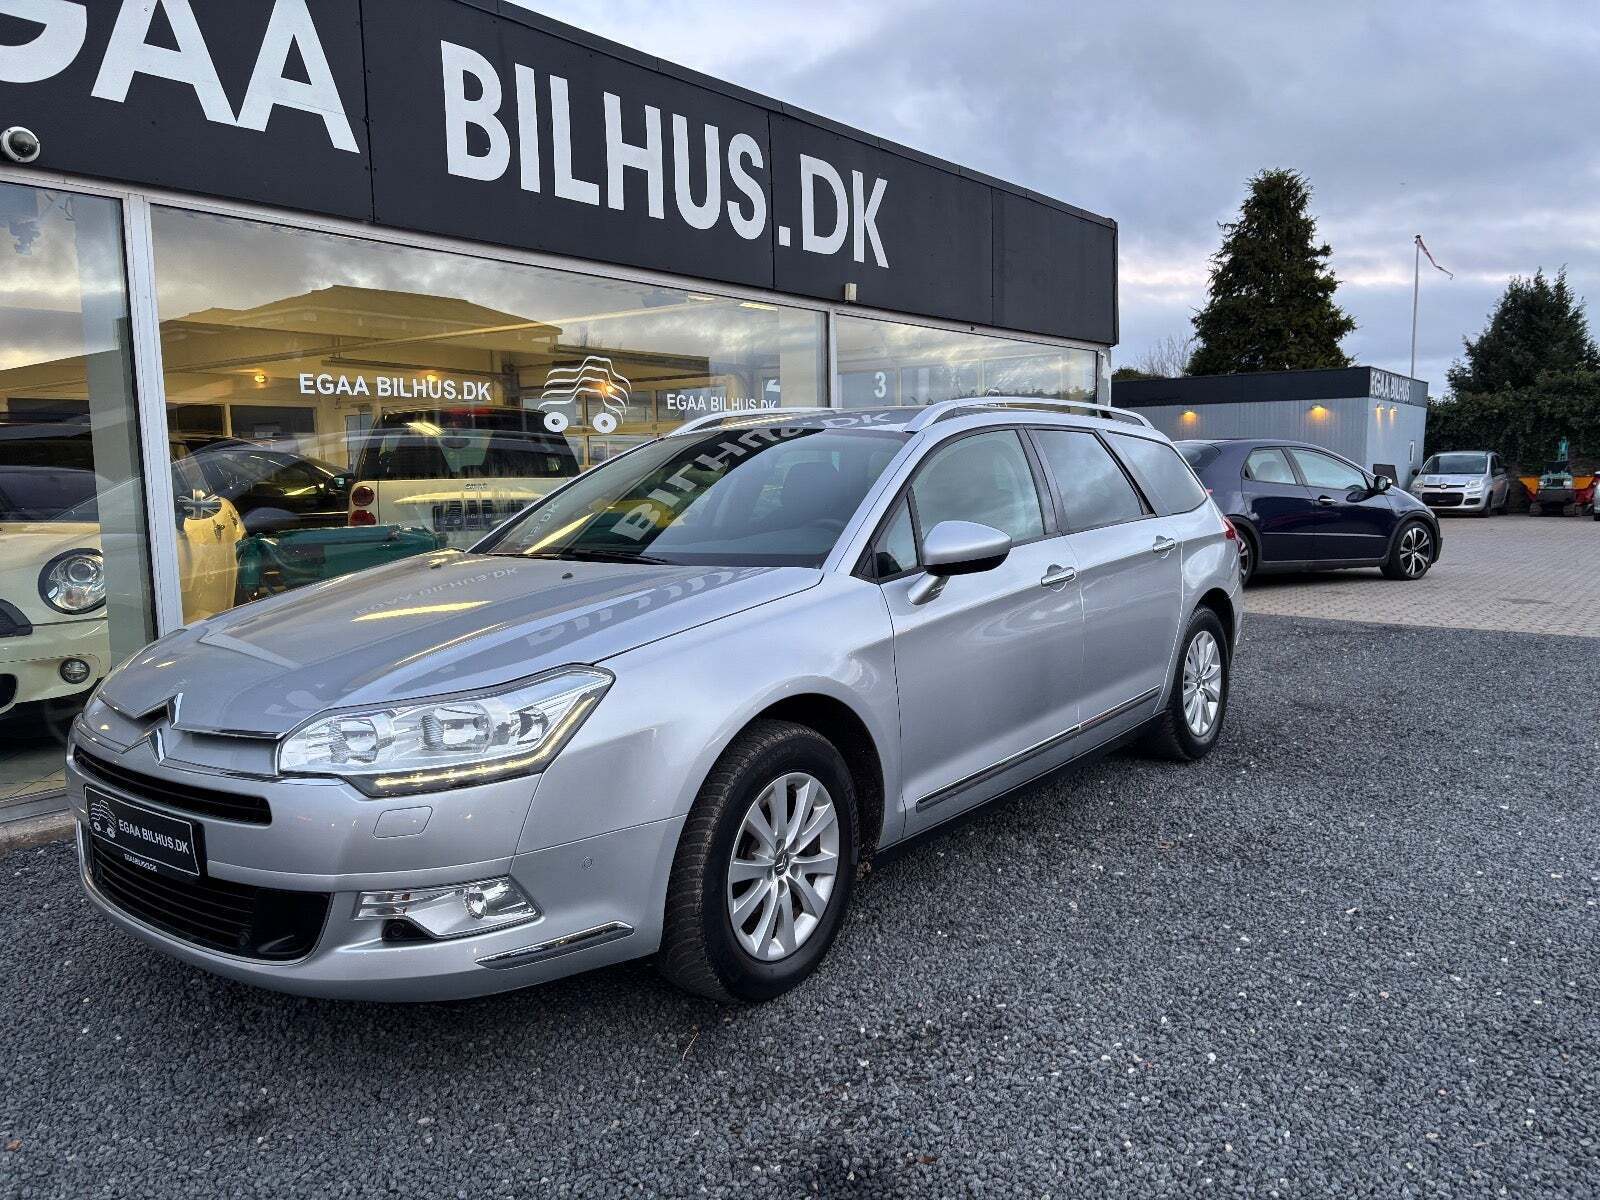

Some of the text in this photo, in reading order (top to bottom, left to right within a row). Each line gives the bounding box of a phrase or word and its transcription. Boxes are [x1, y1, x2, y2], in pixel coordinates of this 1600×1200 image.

[441, 40, 888, 268] BILHUS.DK
[299, 373, 491, 400] EGAA BILHUS.DK
[874, 371, 886, 398] 3
[1370, 371, 1410, 402] EGAA BILHUS
[666, 393, 777, 412] EGAA BILHUSDK
[118, 819, 190, 855] EGAA BILHUS.DK
